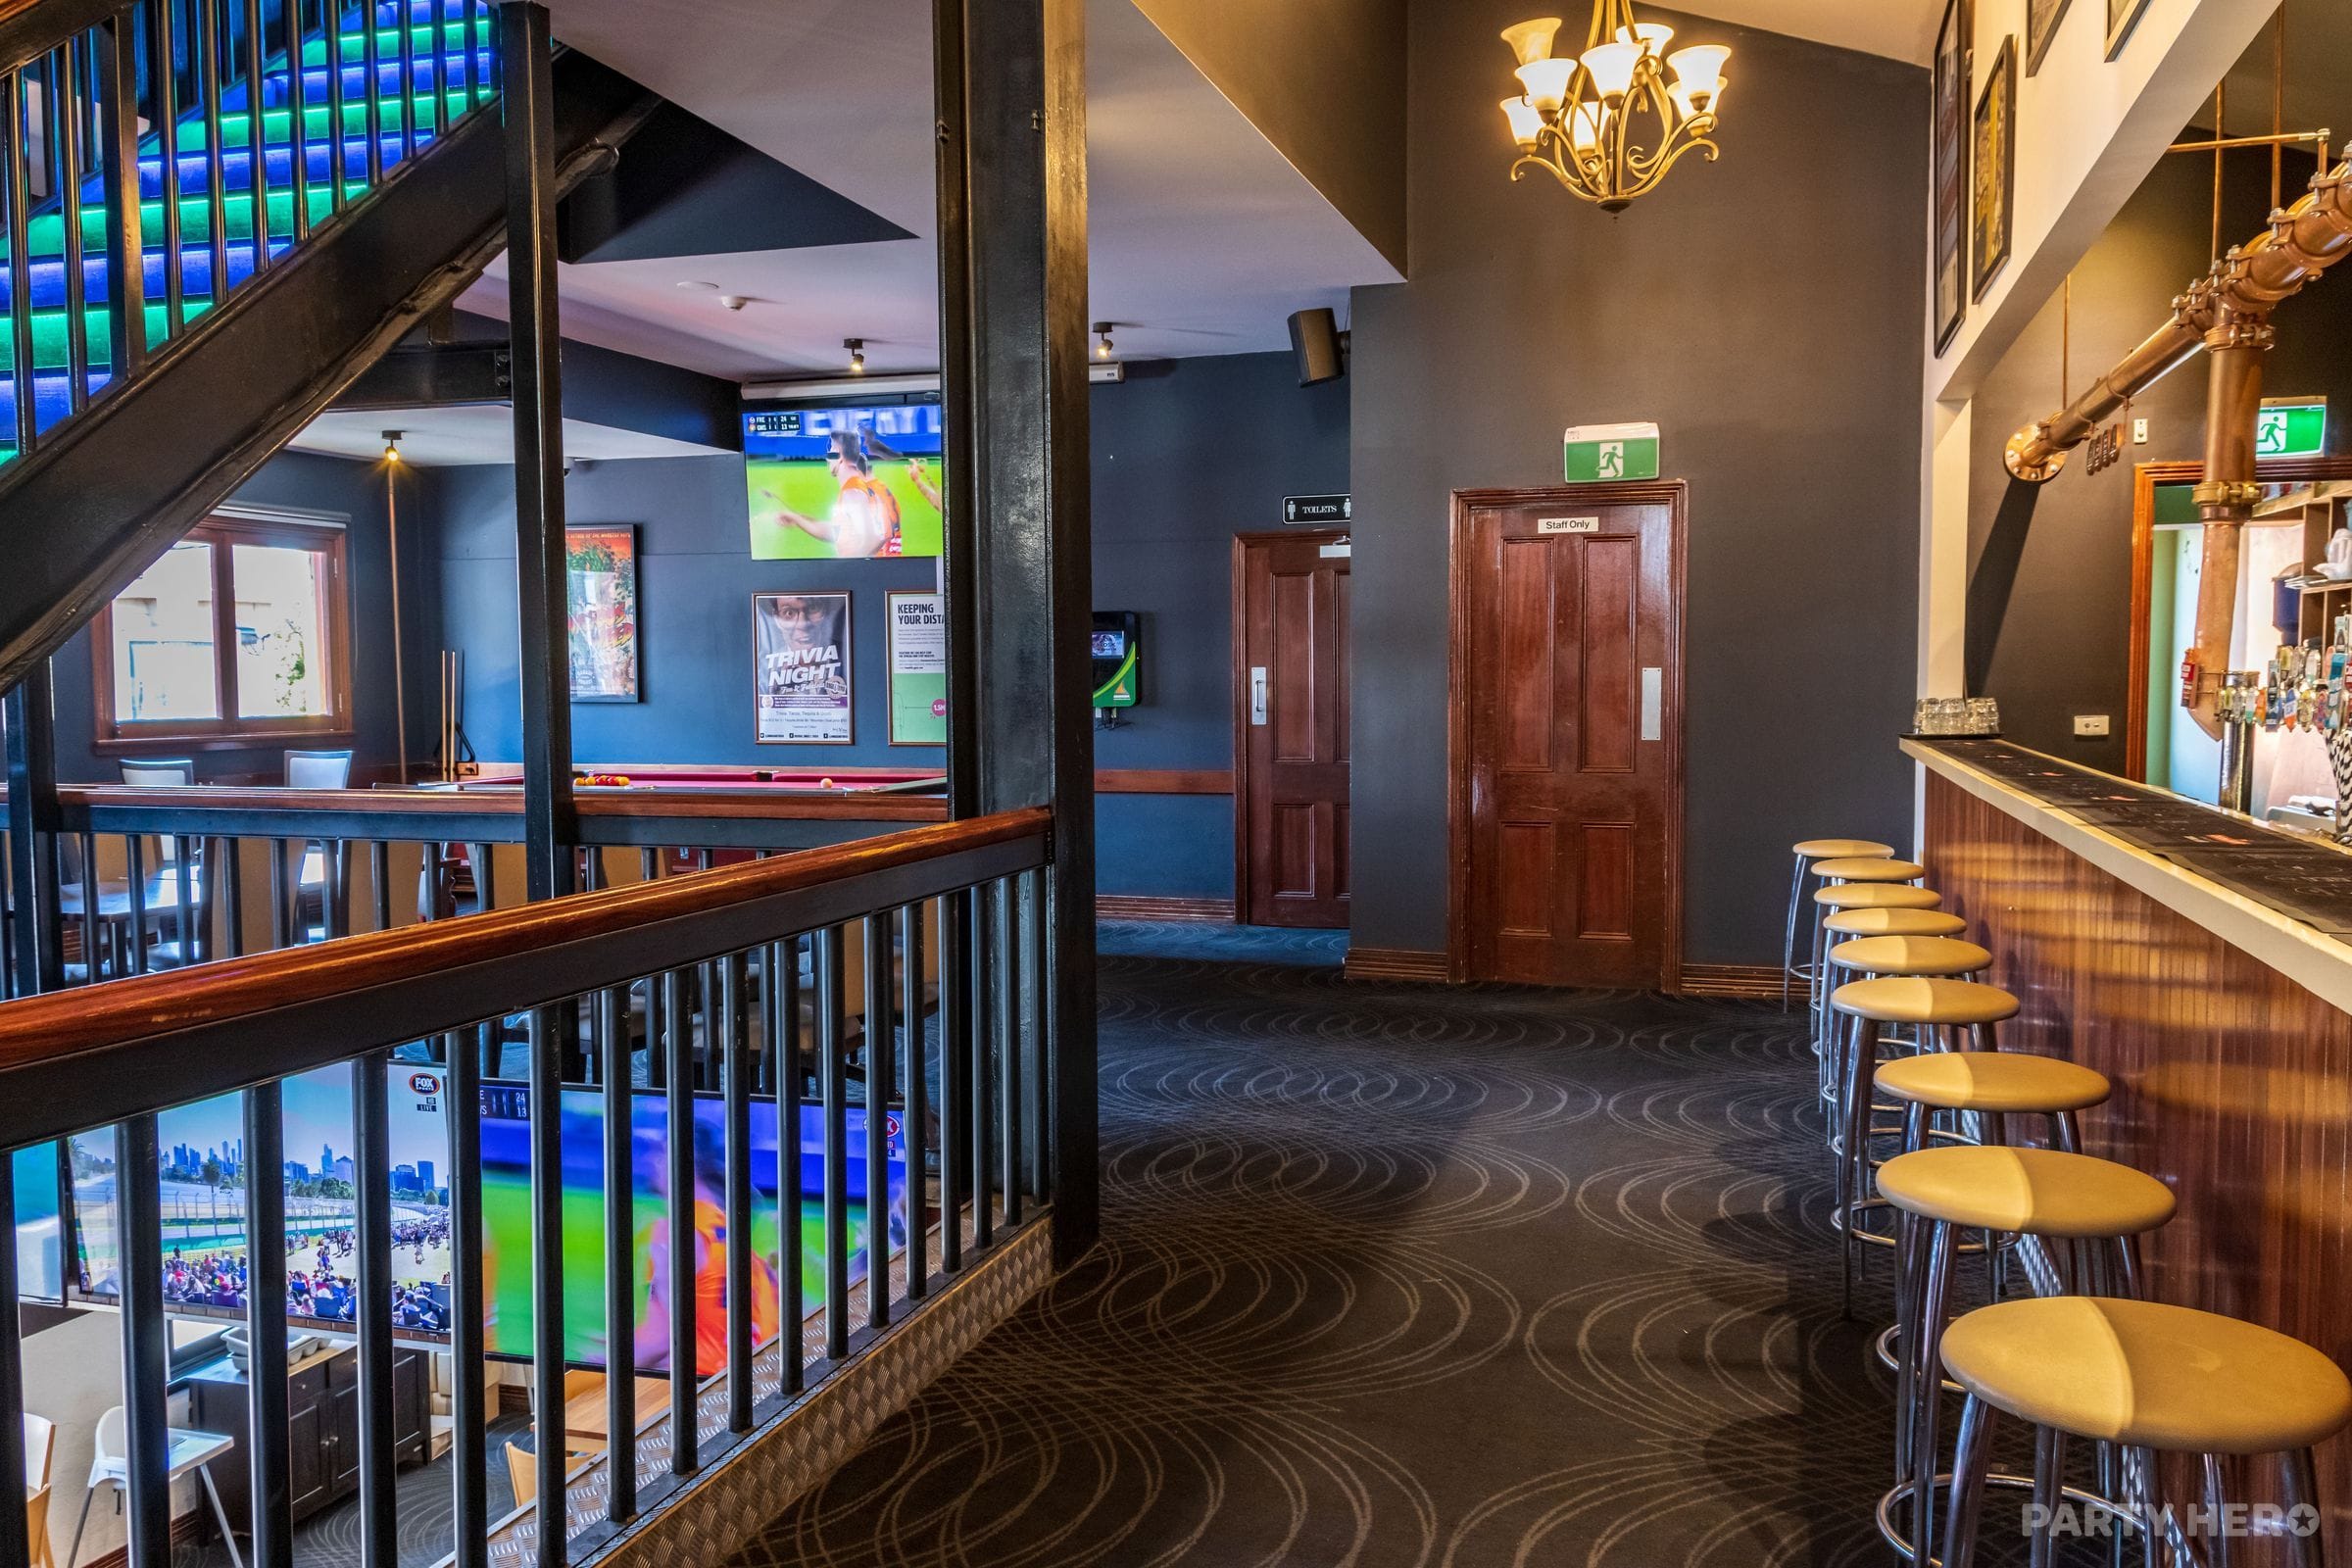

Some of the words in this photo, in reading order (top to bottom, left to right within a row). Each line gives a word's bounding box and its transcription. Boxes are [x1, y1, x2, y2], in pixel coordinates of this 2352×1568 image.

[1301, 505, 1338, 514] TOILETS
[1545, 520, 1568, 530] Staff
[1569, 519, 1591, 530] Only
[898, 603, 934, 614] KEEPING
[898, 613, 922, 625] YOUR
[765, 644, 839, 669] TRIVIA
[768, 662, 842, 687] NIGHT
[415, 1077, 434, 1088] FOX
[515, 1092, 526, 1103] 24
[516, 1107, 527, 1118] 13
